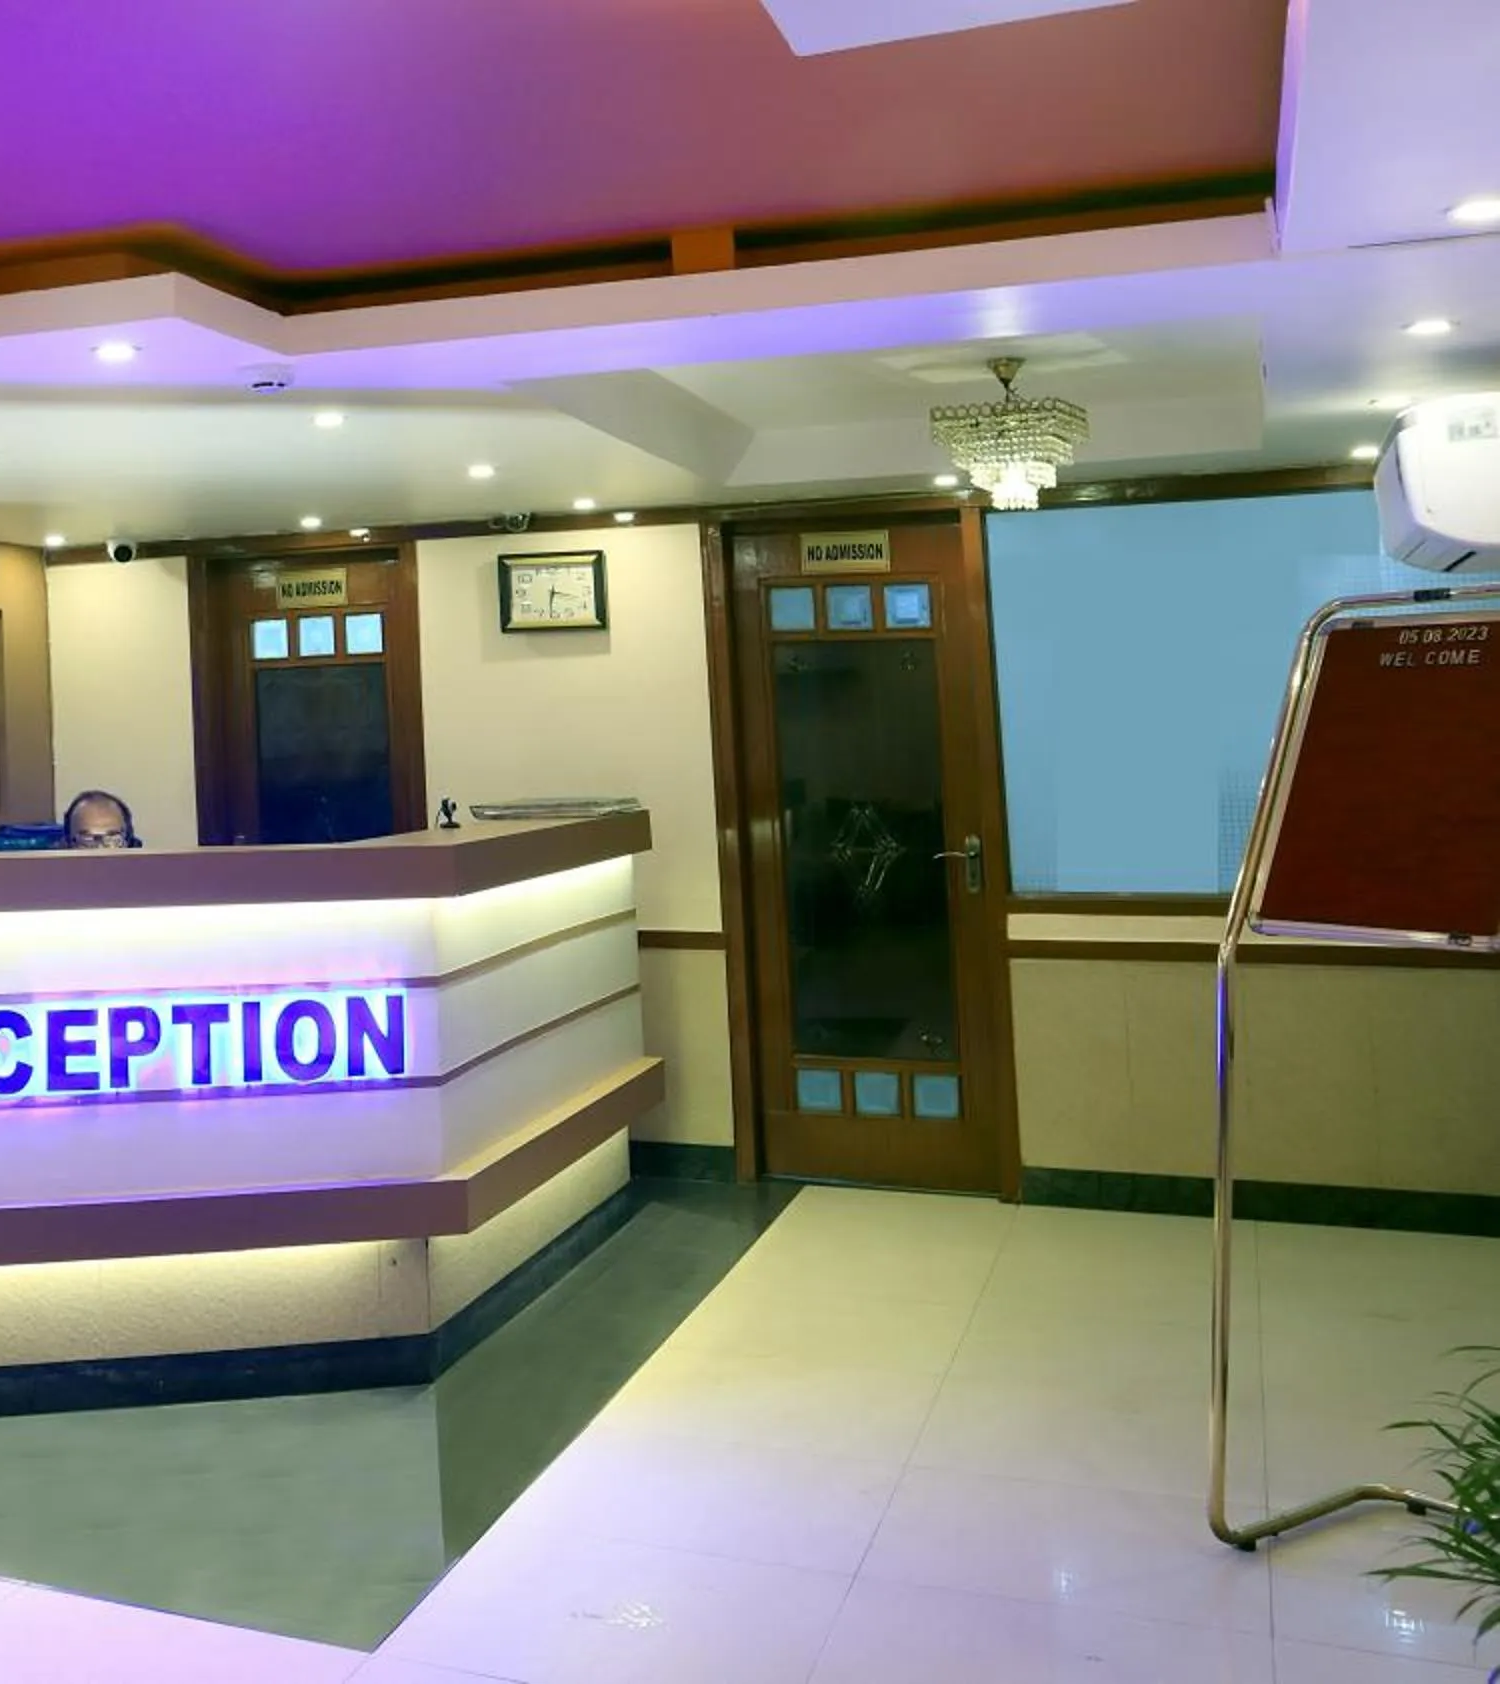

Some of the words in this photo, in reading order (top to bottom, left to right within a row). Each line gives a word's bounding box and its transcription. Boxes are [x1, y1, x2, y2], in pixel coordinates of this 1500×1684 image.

[807, 545, 822, 561] NO
[825, 544, 883, 560] ADMISSION
[1446, 625, 1489, 642] 2023
